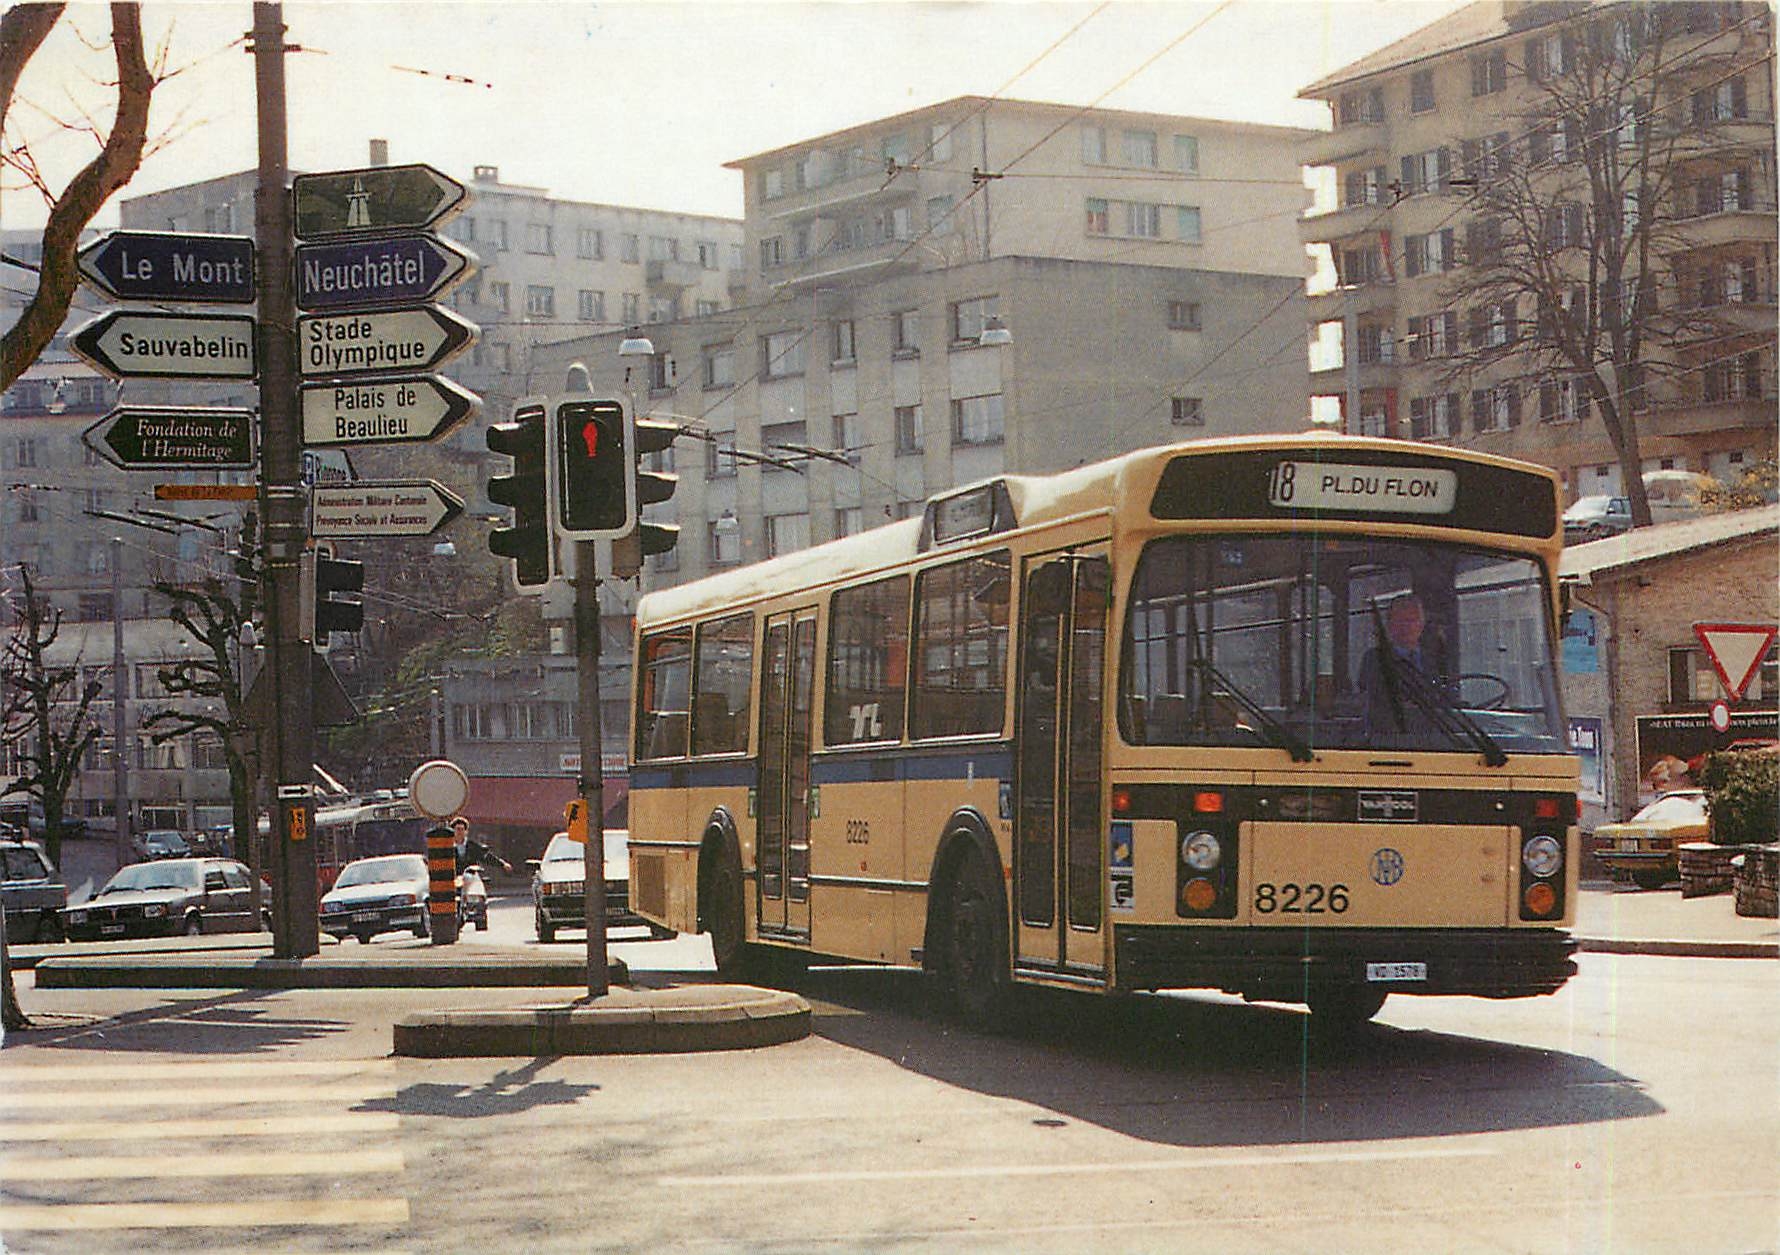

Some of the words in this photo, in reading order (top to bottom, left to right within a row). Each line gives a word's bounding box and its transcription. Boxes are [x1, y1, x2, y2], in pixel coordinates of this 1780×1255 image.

[121, 250, 153, 281] Le
[172, 253, 244, 284] Mont
[304, 250, 425, 294] Neuchâtel
[310, 318, 372, 342] Stade
[119, 332, 249, 360] Sauvabelin
[310, 340, 425, 371] Olympique
[334, 387, 385, 410] Palais
[396, 384, 417, 407] de
[136, 419, 214, 437] Fondation
[219, 420, 237, 438] de
[335, 414, 408, 438] Beaulieu
[1270, 463, 1297, 502] 18
[1383, 478, 1439, 498] FLON
[845, 819, 870, 845] 8226
[1254, 882, 1350, 914] 8226
